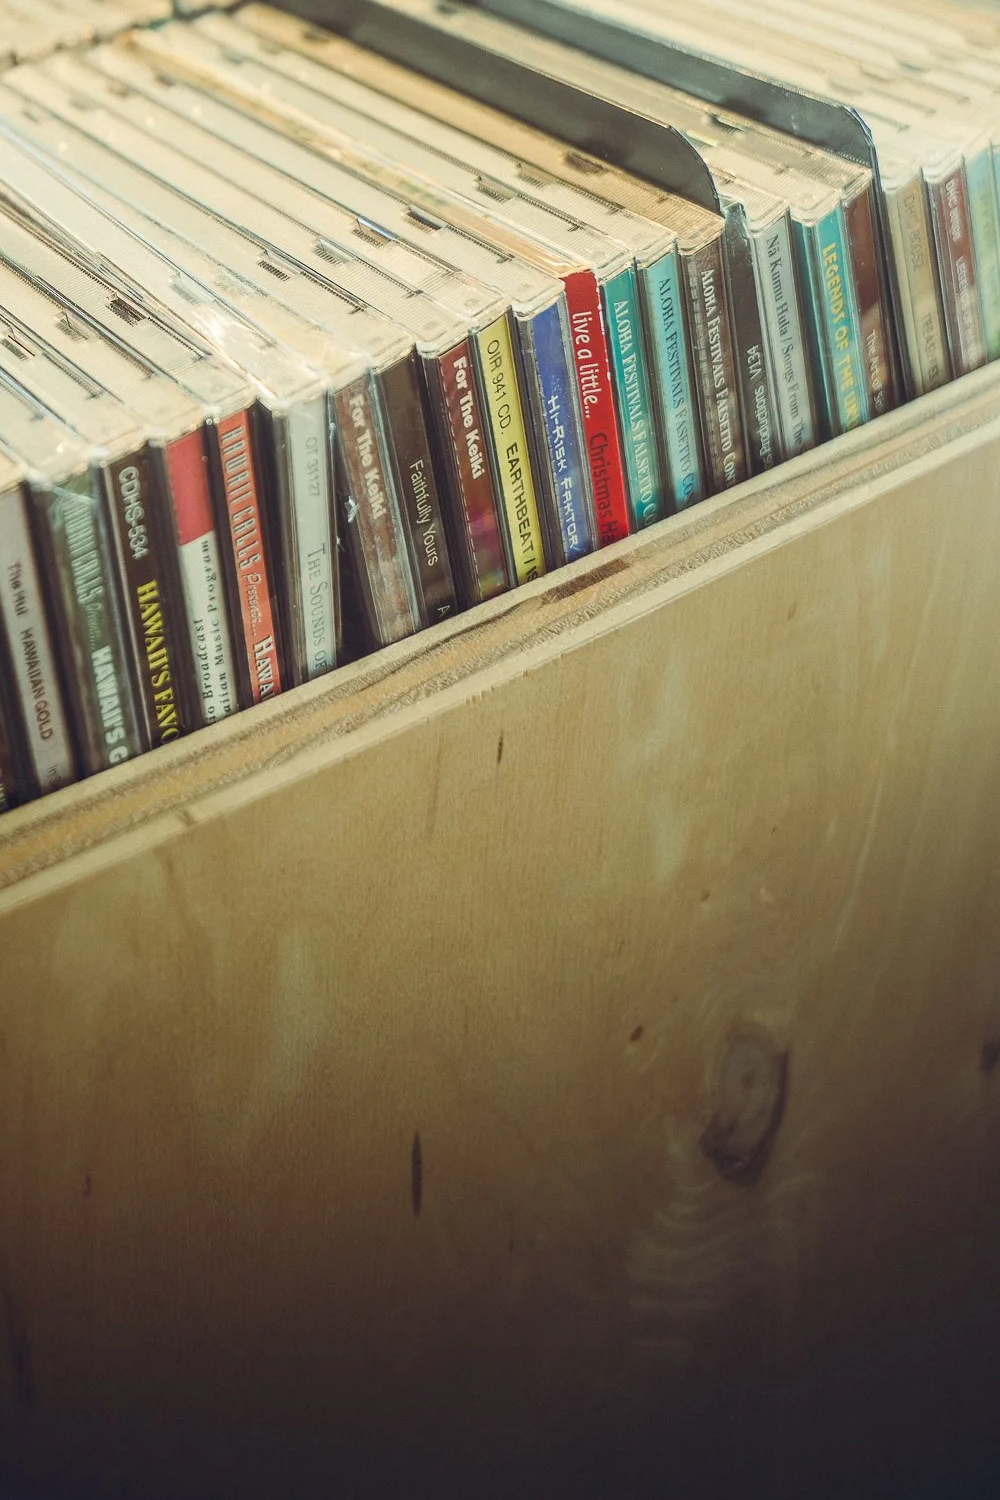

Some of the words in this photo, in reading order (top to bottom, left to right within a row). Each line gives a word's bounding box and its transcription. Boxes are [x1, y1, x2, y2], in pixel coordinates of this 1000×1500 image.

[659, 277, 675, 332] ALOHA
[701, 269, 716, 317] ALOHA
[769, 257, 783, 302] Kumu
[822, 242, 845, 324] LEGENDS
[572, 311, 593, 345] live
[614, 300, 633, 355] ALOHA
[776, 301, 792, 338] Hula
[834, 325, 849, 351] OF
[453, 356, 468, 390] For
[487, 339, 503, 372] OIR
[577, 348, 592, 360] a
[665, 331, 685, 409] FESTIVALS
[708, 315, 726, 389] FESTIVALS
[747, 344, 762, 380] V134
[781, 343, 796, 384] Songs
[838, 353, 855, 391] THE
[349, 393, 366, 428] For
[459, 390, 474, 428] The
[492, 372, 507, 402] 941
[579, 363, 602, 419] little...
[622, 352, 645, 432] FESTIVALS
[787, 383, 801, 419] From
[498, 404, 512, 435] CD.
[715, 388, 733, 452] FALSETTO
[753, 385, 771, 456] Productions
[221, 426, 253, 506] HAWAII
[357, 429, 374, 468] The
[466, 428, 485, 480] Keiki
[590, 431, 613, 517] Christmas
[632, 430, 654, 503] FALSETTO
[119, 466, 150, 560] CDHS-534
[365, 468, 387, 520] Keiki
[410, 459, 432, 525] Faithfully
[423, 524, 439, 567] Yours
[506, 442, 534, 554] EARTHBEAT
[232, 505, 262, 570] CALLS
[307, 542, 327, 581] THE
[201, 540, 218, 613] Program
[136, 580, 172, 688] HAWAII'S
[309, 580, 328, 647] SOUNDS
[193, 618, 214, 700] Broadcast
[210, 619, 225, 666] Music
[20, 627, 46, 699] HAWAIIAN
[34, 699, 54, 740] GOLD
[91, 646, 126, 744] HAWAII'S
